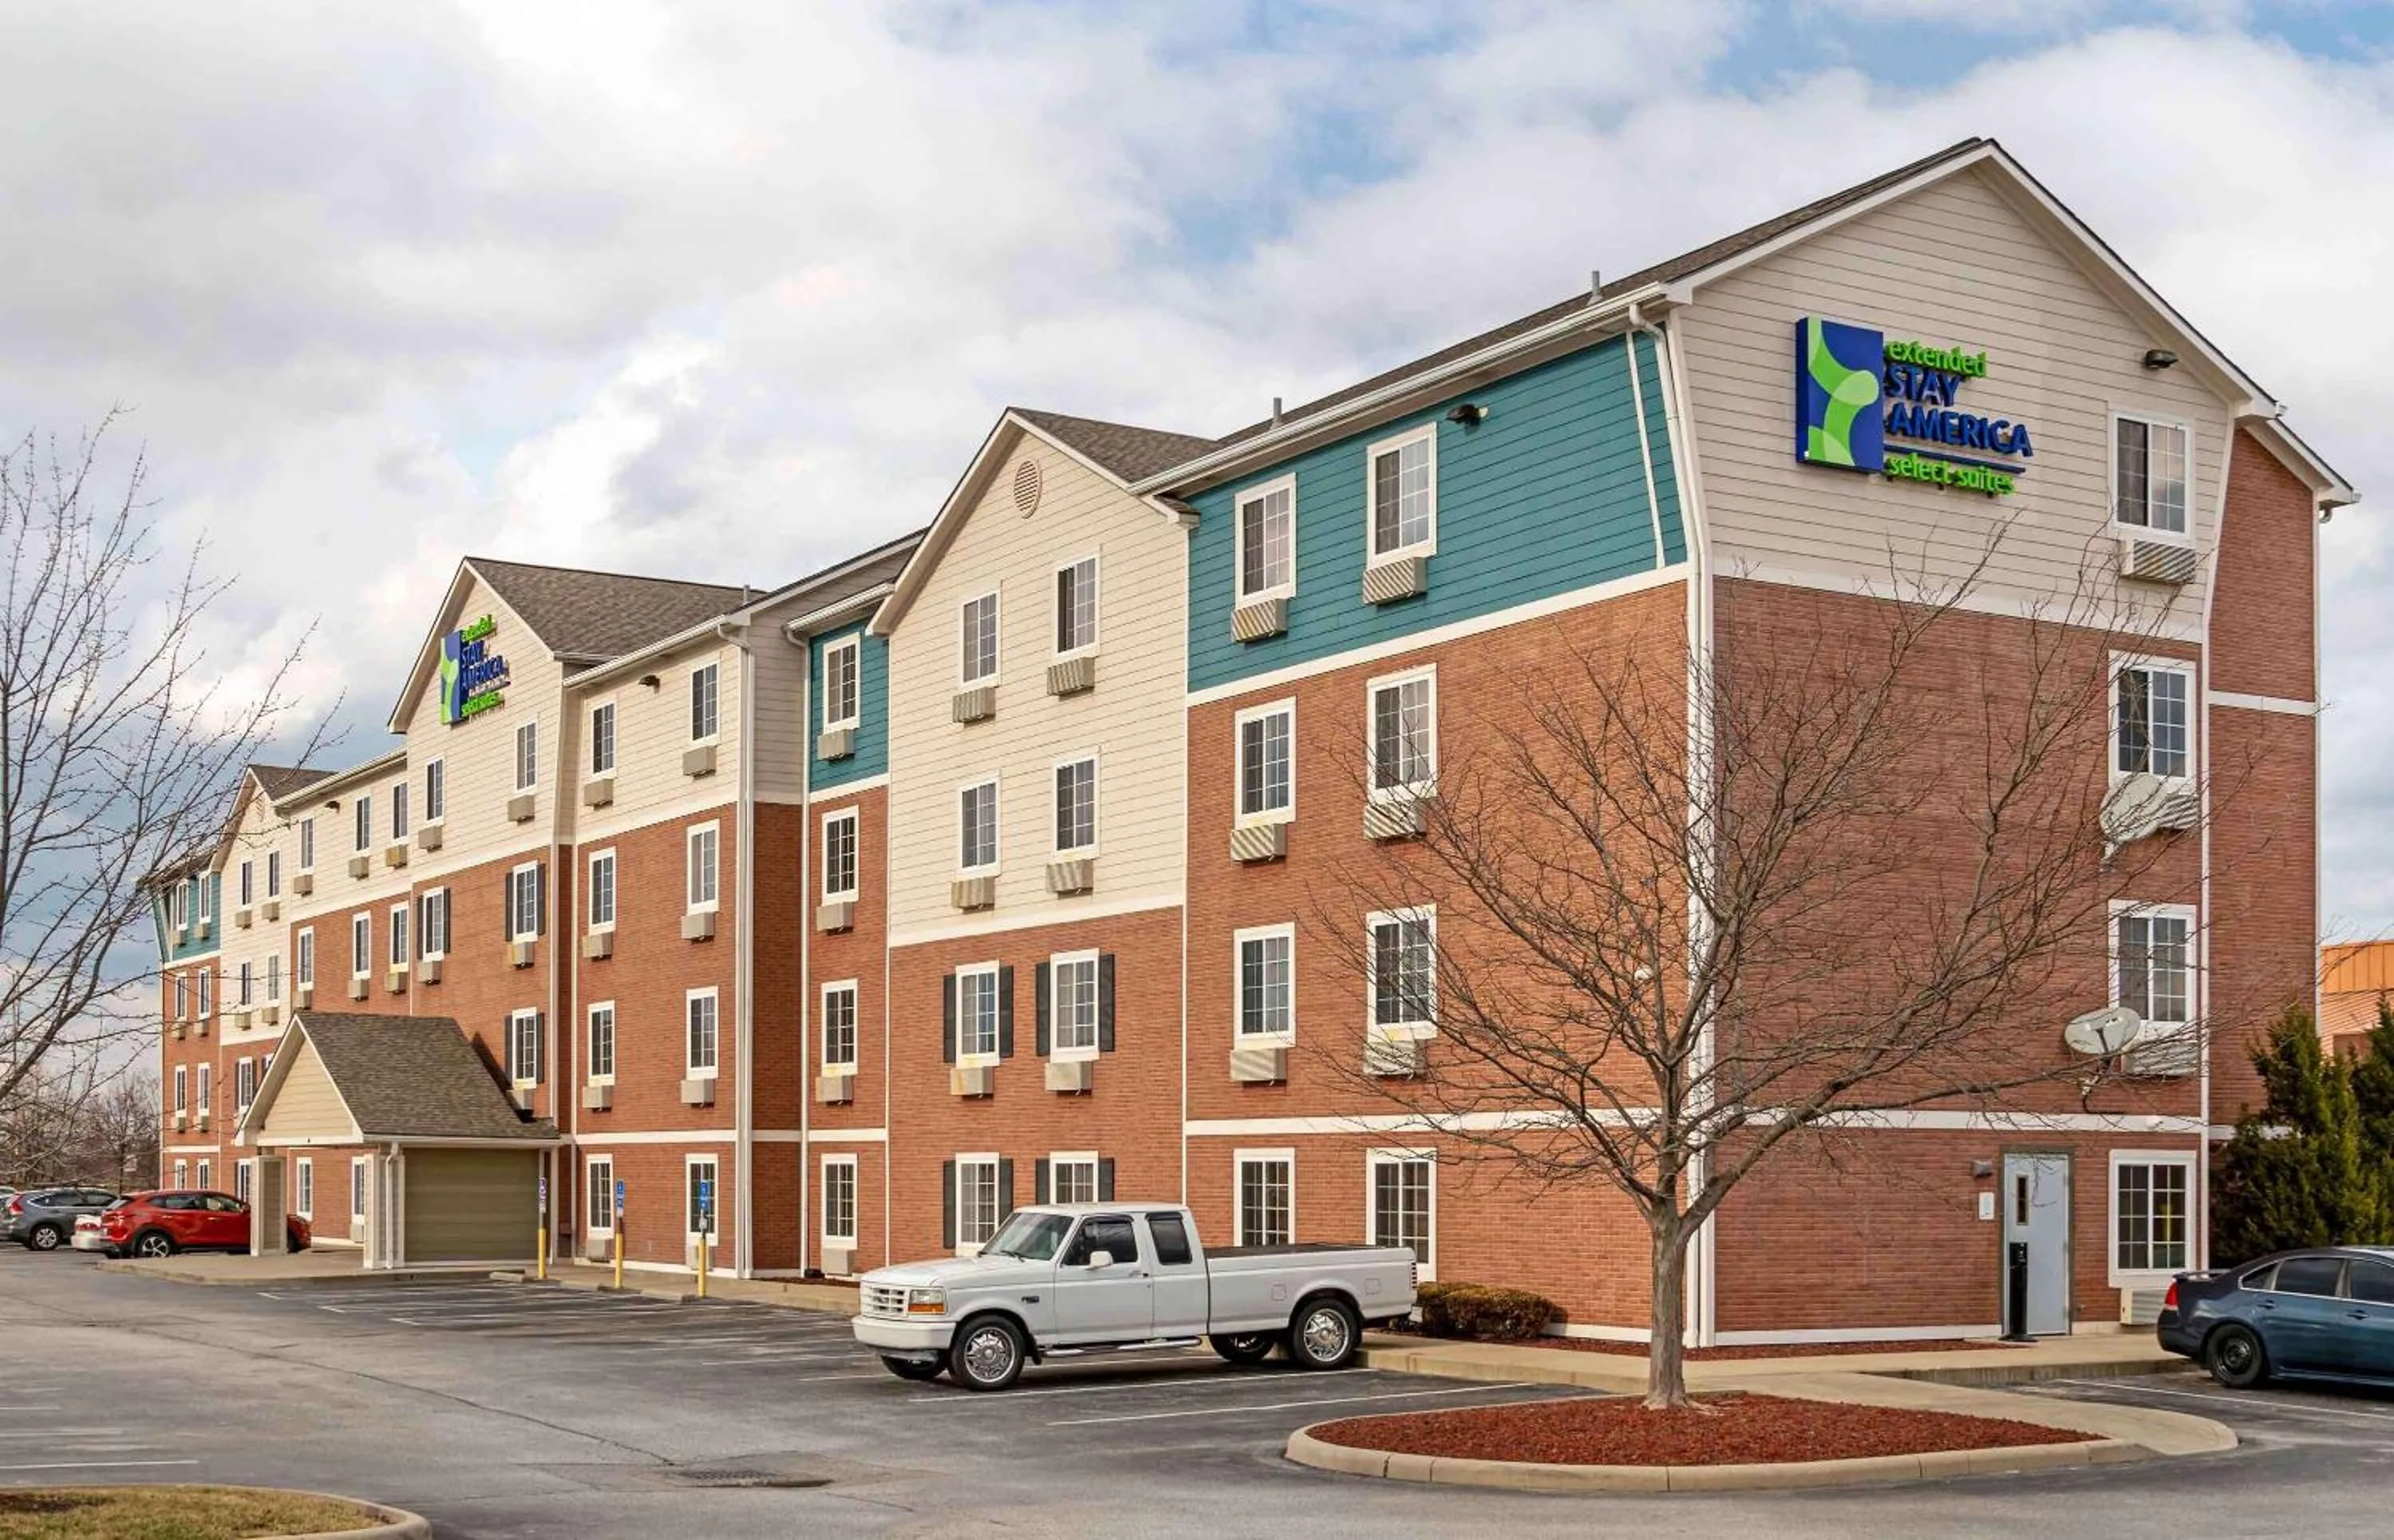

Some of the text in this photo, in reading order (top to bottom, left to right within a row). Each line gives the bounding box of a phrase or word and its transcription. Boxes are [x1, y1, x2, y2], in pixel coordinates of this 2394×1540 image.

[1886, 341, 1986, 377] extended
[1886, 364, 1961, 407] STAY
[1886, 402, 2033, 456] AMERICA
[1886, 452, 2015, 496] select suites
